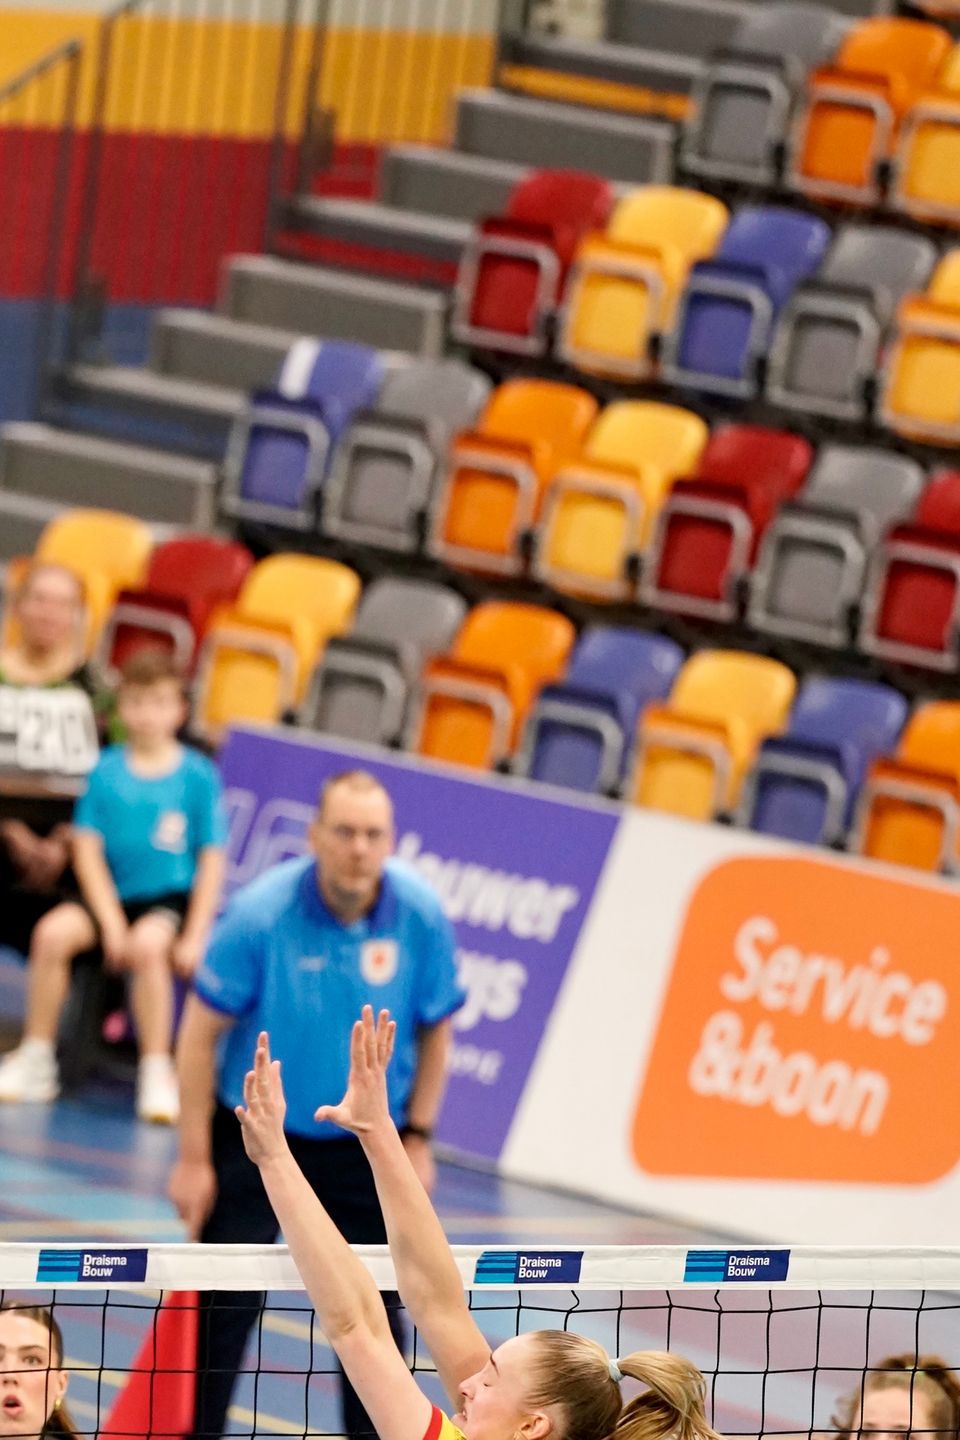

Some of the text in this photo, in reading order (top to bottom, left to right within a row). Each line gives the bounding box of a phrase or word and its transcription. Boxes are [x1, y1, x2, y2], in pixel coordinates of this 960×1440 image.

[719, 914, 947, 1046] Service
[687, 1010, 891, 1138] &boon
[83, 1253, 127, 1267] Draisma
[519, 1255, 562, 1268] Draisma
[728, 1255, 770, 1267] Draisma
[82, 1265, 114, 1278] Bouw
[518, 1266, 549, 1279] Bouw
[727, 1266, 756, 1278] Bouw
